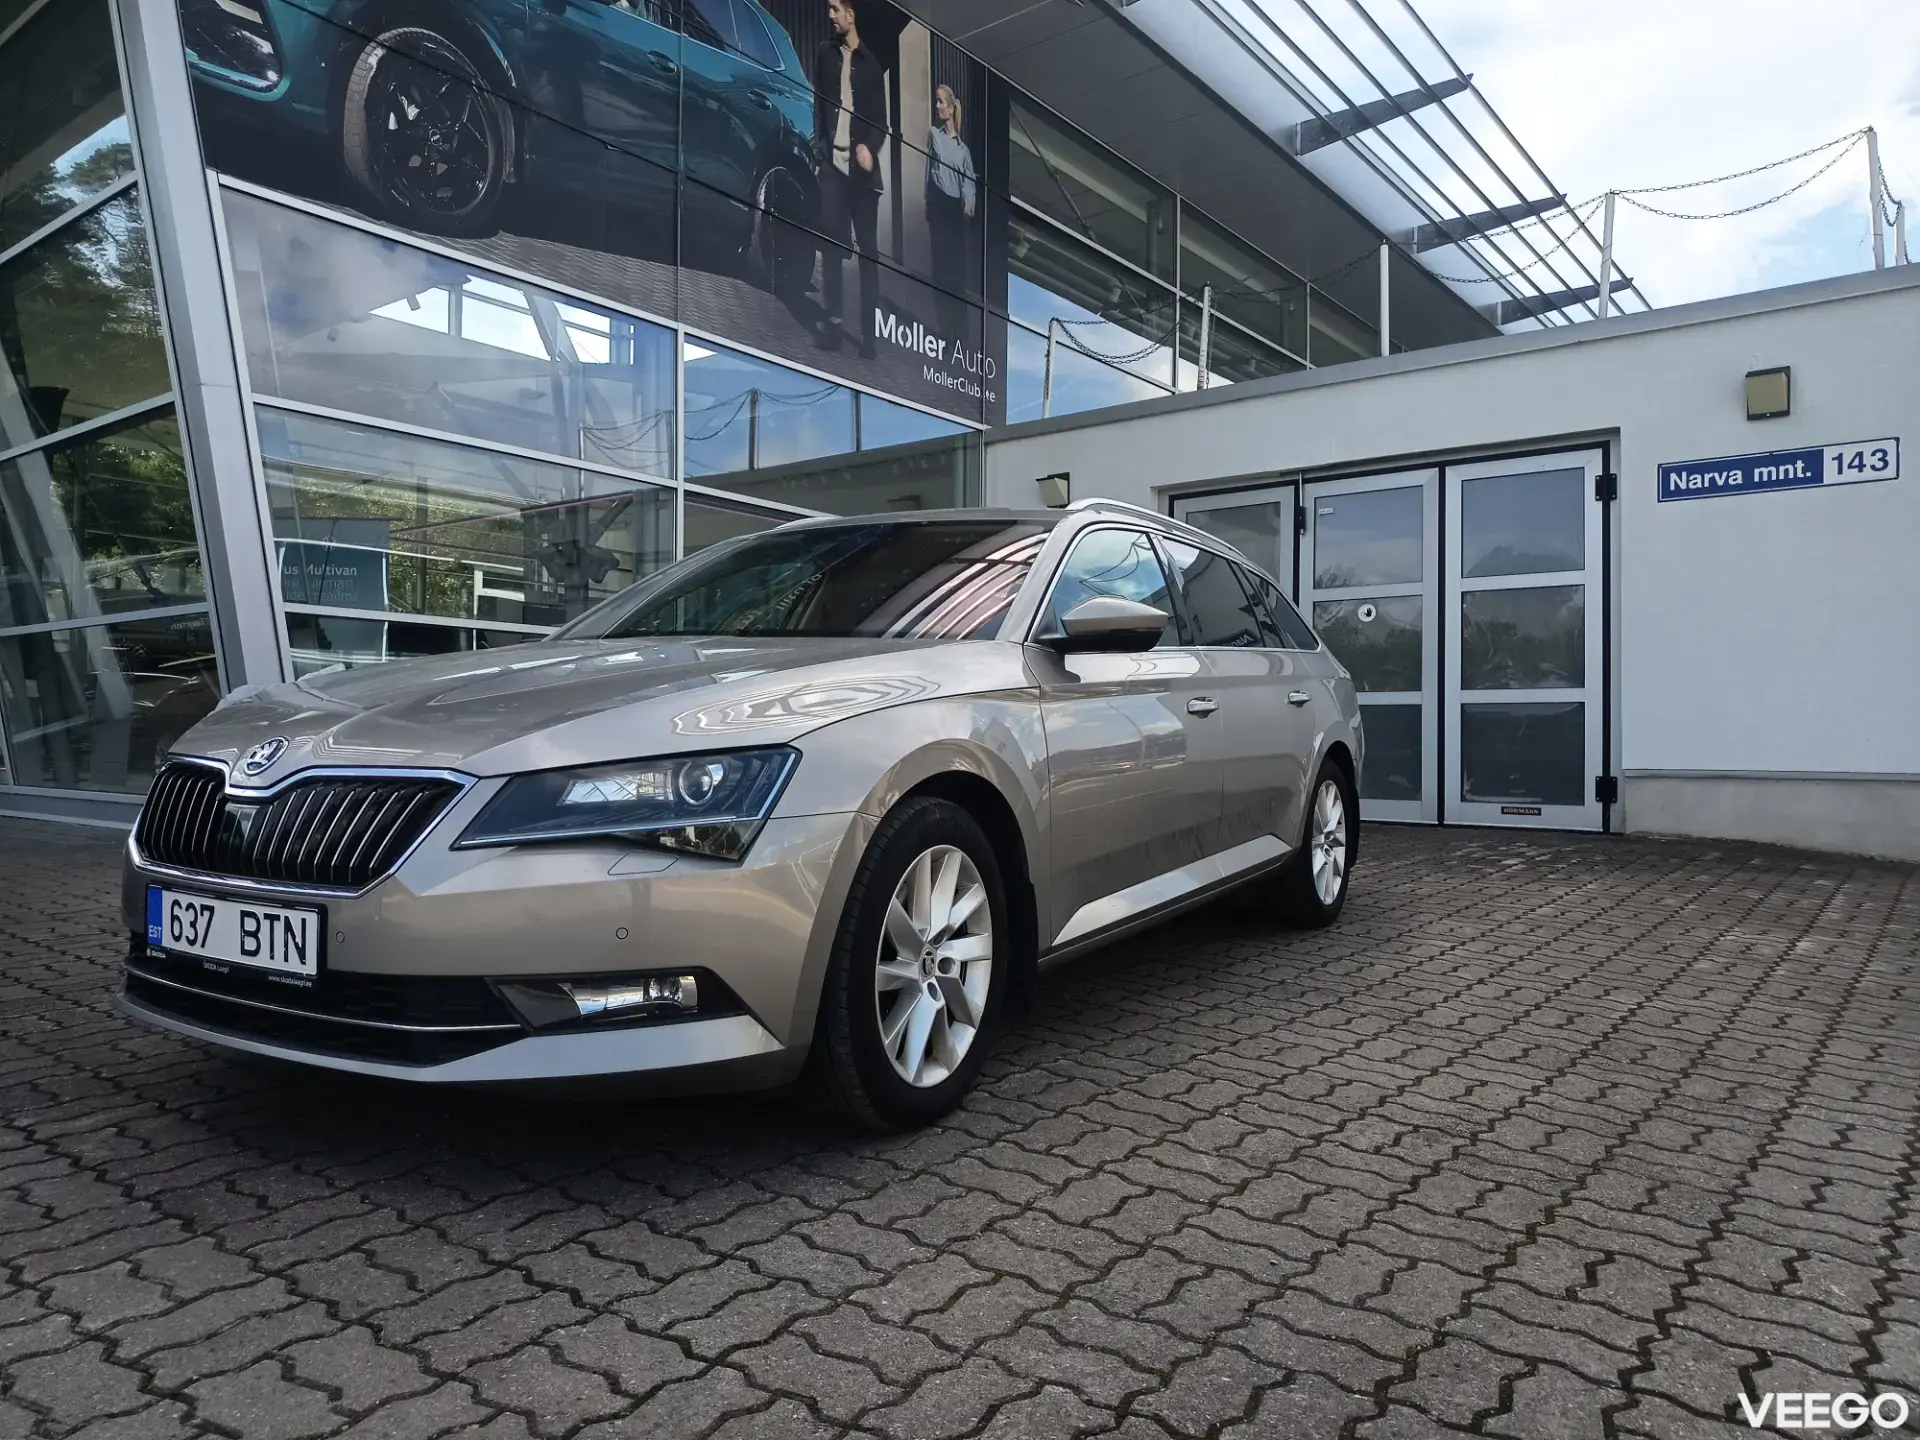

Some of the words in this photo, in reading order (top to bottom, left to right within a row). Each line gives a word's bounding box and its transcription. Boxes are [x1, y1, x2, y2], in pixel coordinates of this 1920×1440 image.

[951, 339, 996, 379] Auto
[1669, 469, 1743, 491] Narva
[1753, 460, 1812, 482] mnt.
[1831, 448, 1889, 475] 143
[282, 563, 300, 575] us
[306, 562, 357, 576] Mutivan
[149, 925, 162, 939] EST
[170, 899, 215, 948] 637
[240, 910, 307, 965] BTN
